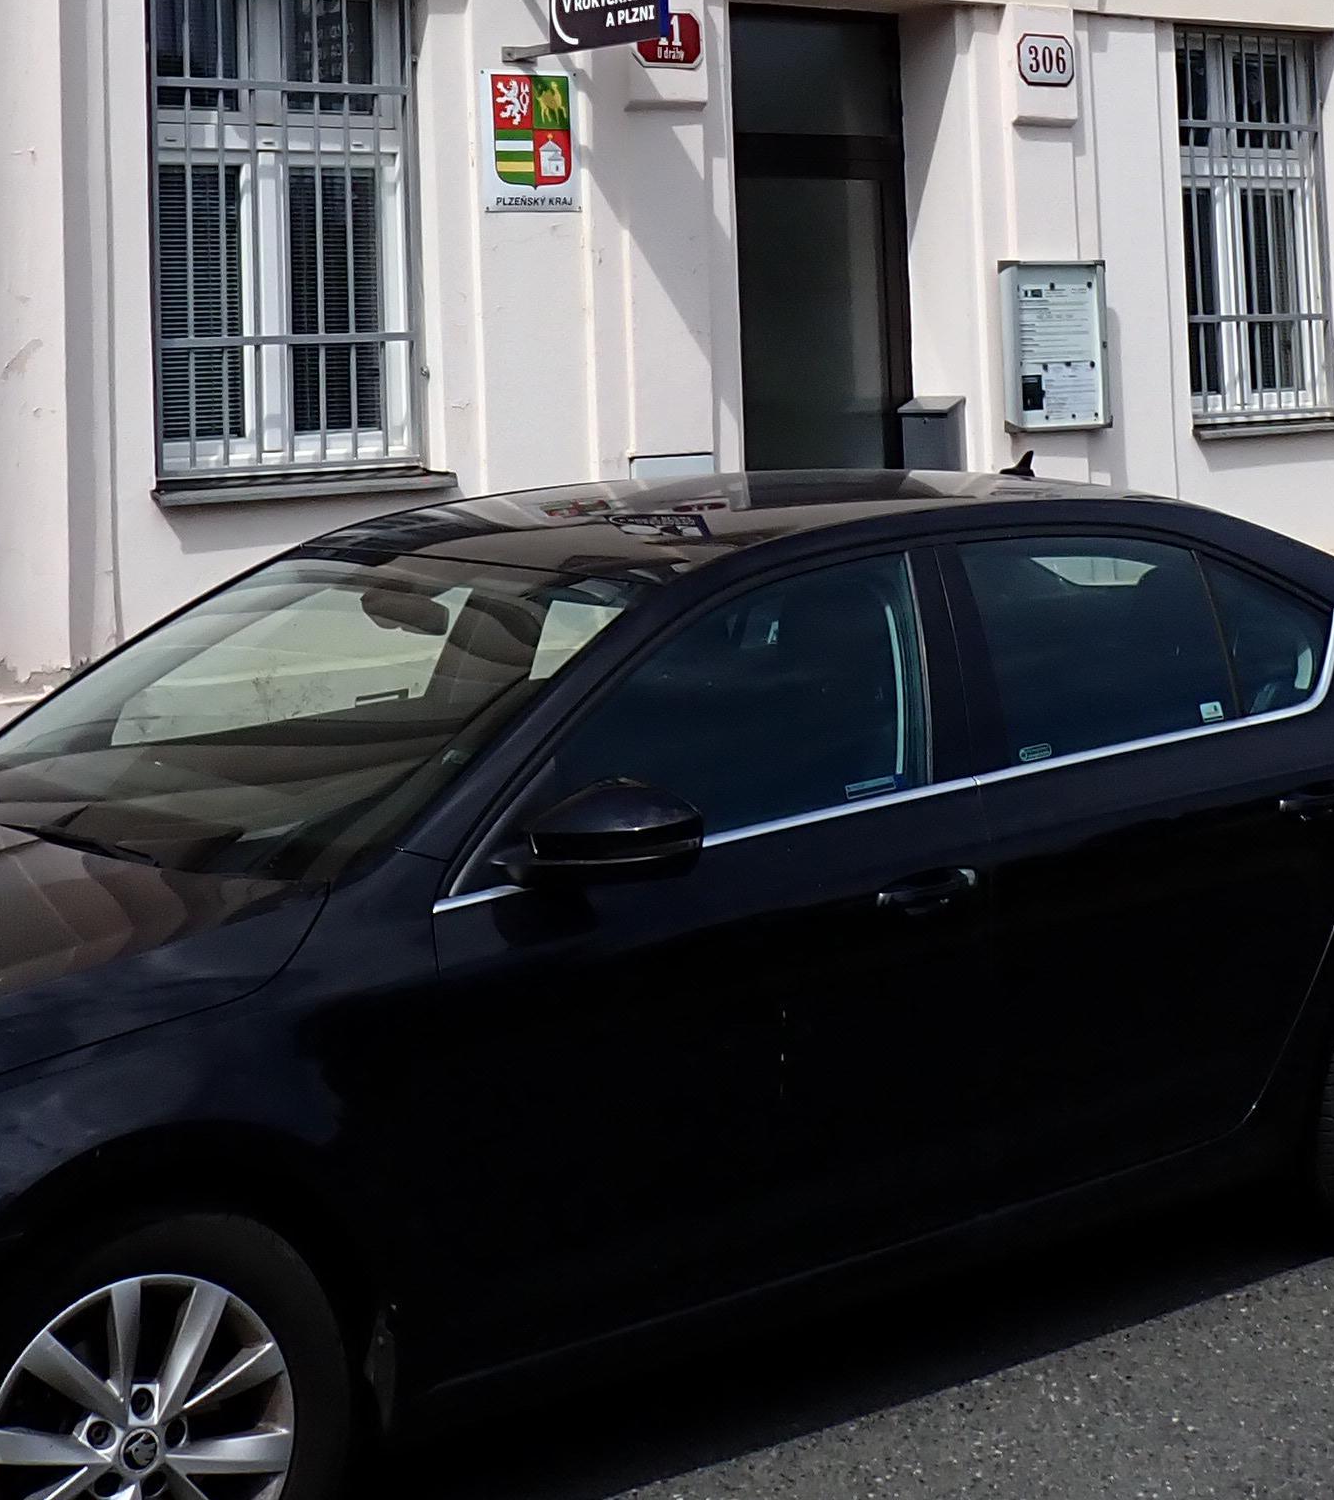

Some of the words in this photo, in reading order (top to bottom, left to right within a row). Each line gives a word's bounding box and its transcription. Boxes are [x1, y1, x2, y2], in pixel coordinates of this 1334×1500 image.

[605, 11, 615, 27] A
[617, 4, 654, 25] PLZNI
[658, 14, 682, 46] 1
[657, 47, 663, 59] U
[1028, 45, 1066, 74] 306
[495, 195, 546, 206] PLZEŇSKÝ
[548, 197, 573, 206] KRAJ
